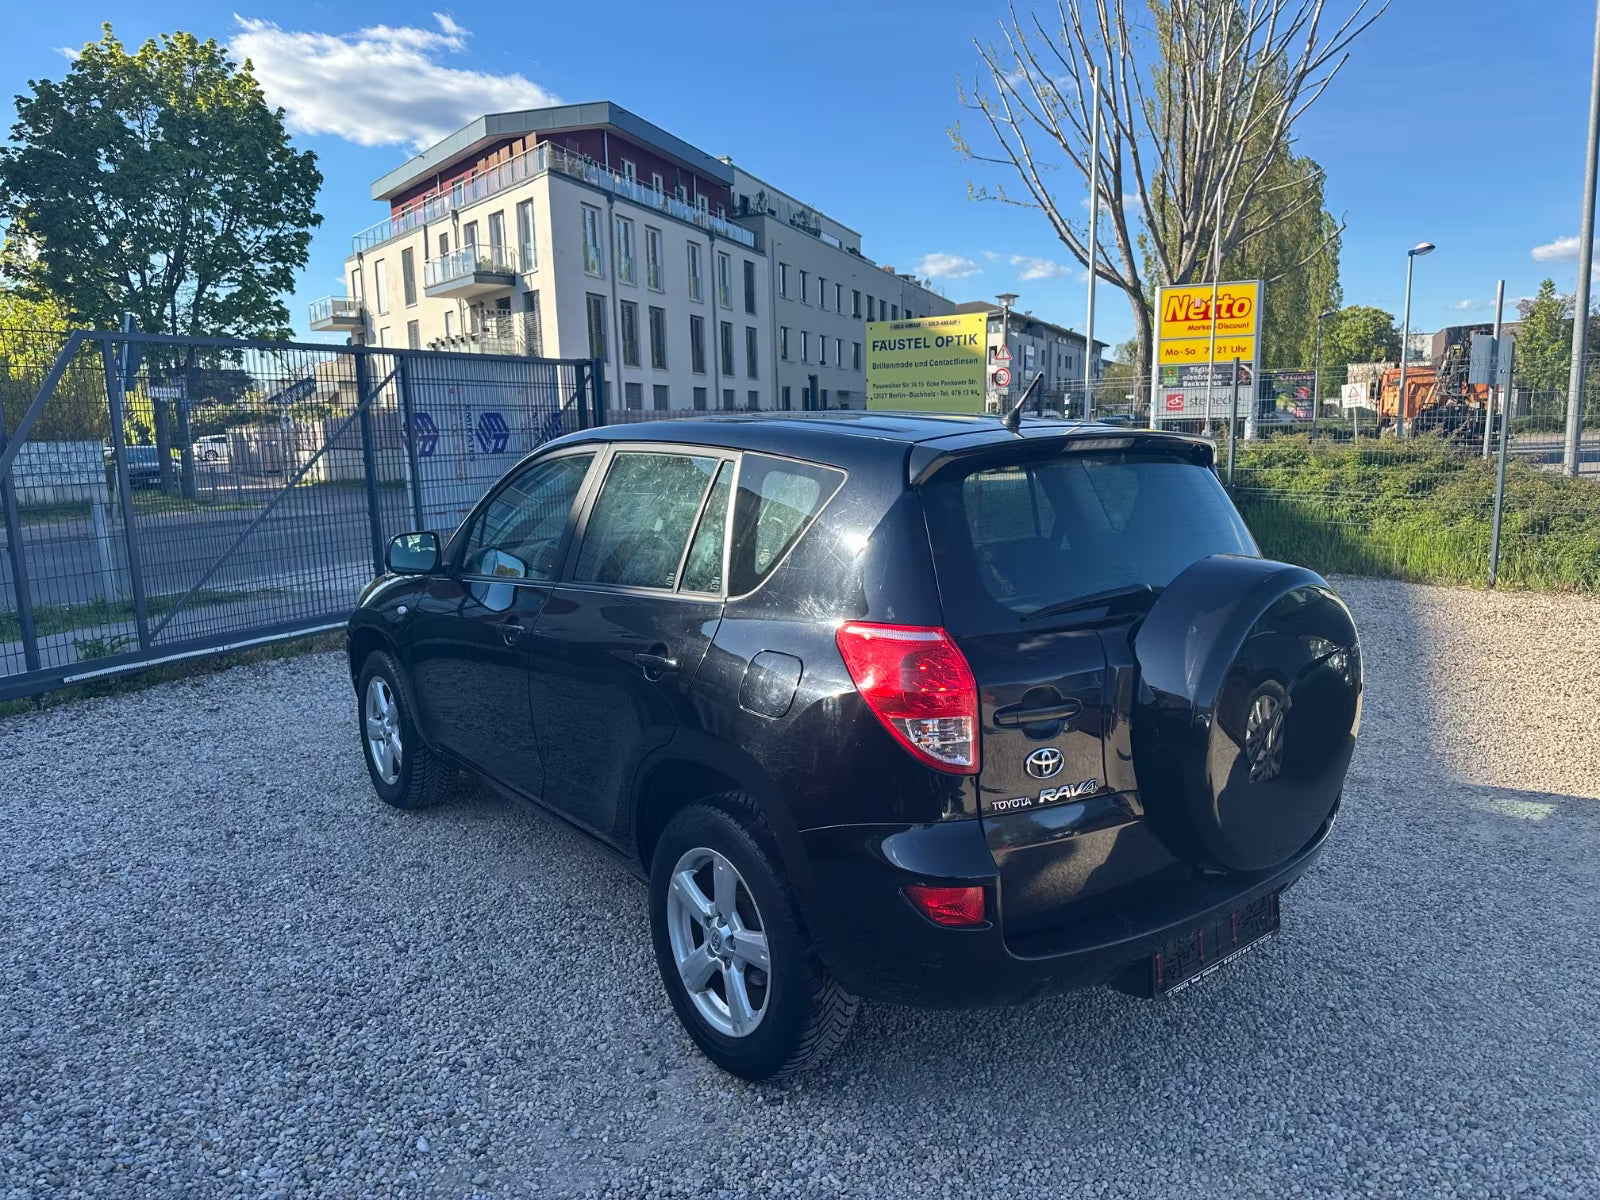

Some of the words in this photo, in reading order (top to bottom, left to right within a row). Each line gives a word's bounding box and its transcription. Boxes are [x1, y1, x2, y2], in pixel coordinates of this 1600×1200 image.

[1165, 294, 1251, 322] Netto
[872, 337, 930, 352] FÄUSTEL
[935, 333, 978, 348] OPTIK
[1231, 345, 1247, 353] Uhr
[872, 360, 913, 370] Brillenmode
[915, 359, 928, 368] und
[930, 357, 978, 367] Contactlinsen
[992, 797, 1031, 811] TOYOTA
[1039, 779, 1099, 803] RAV4
